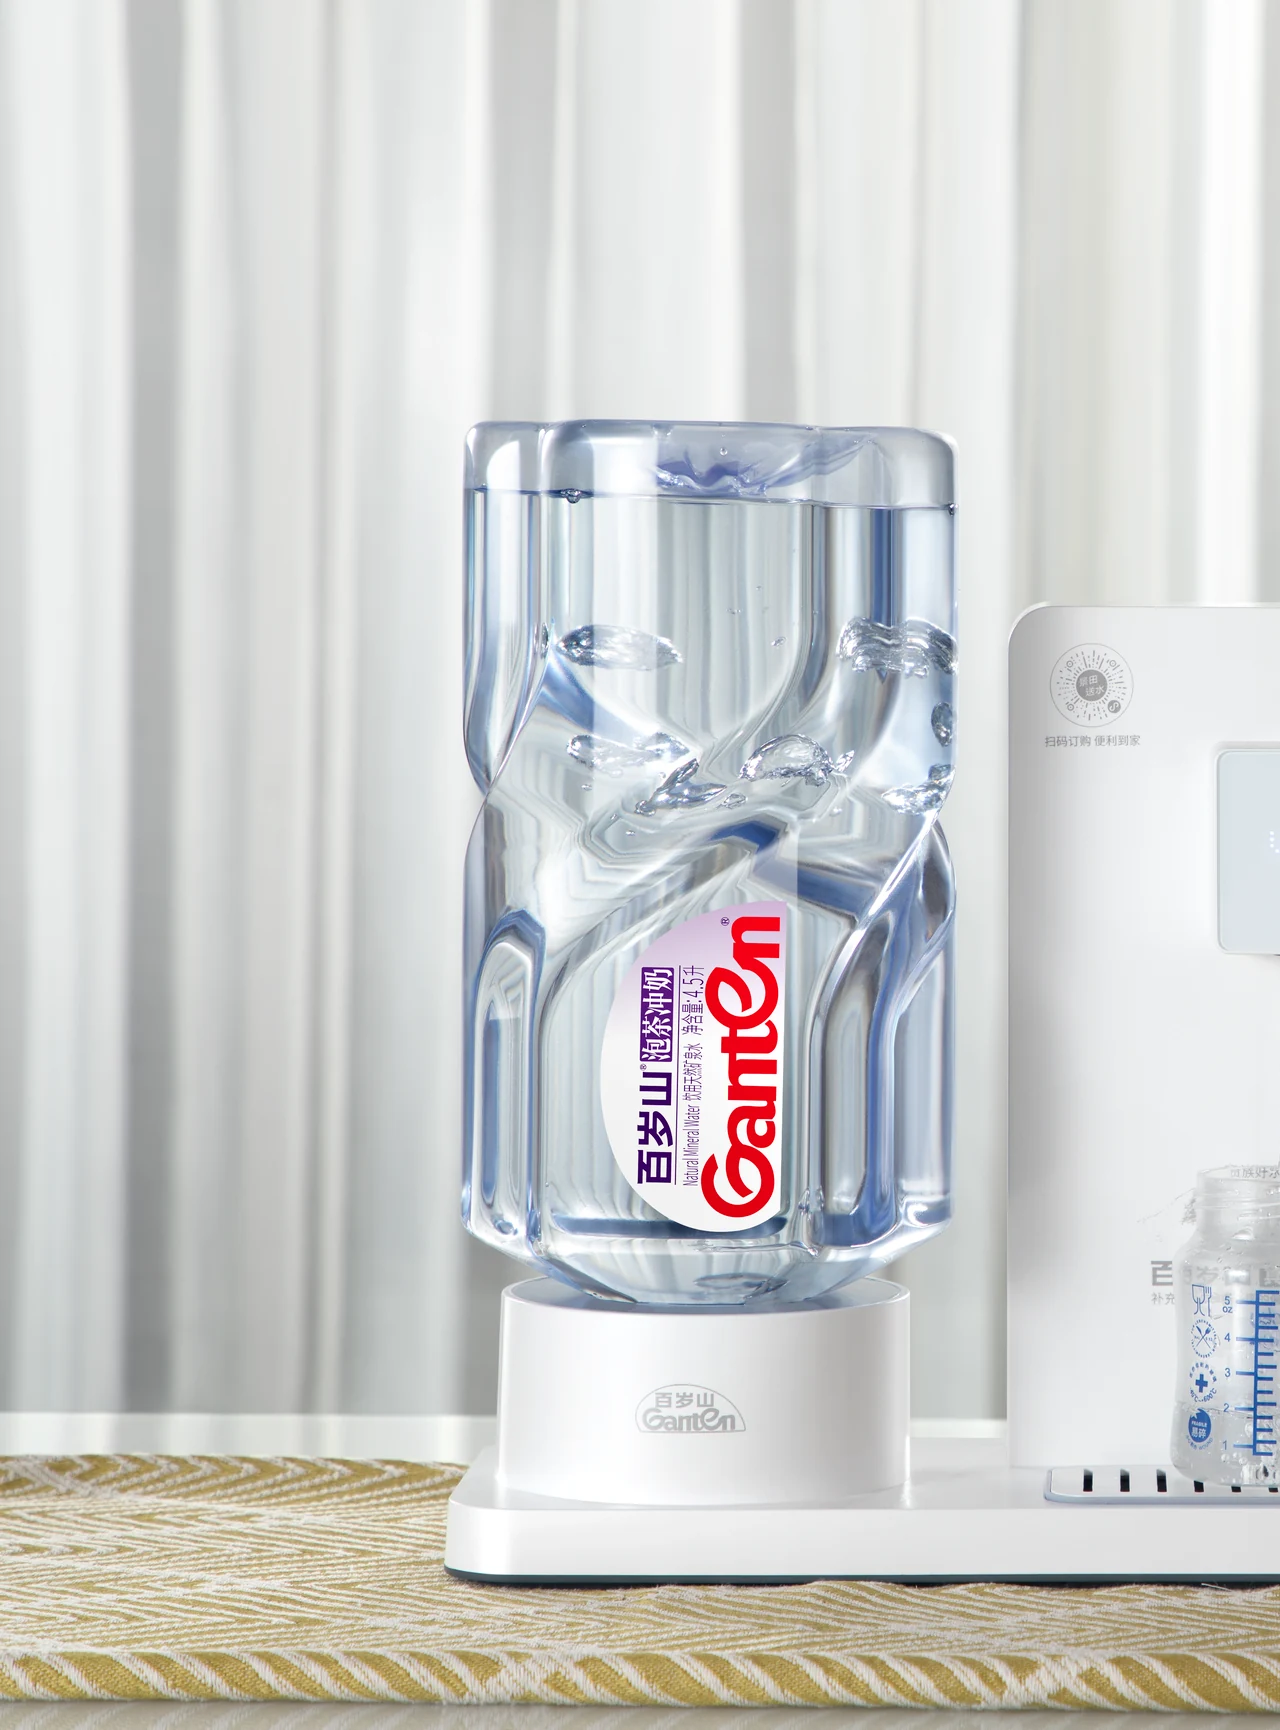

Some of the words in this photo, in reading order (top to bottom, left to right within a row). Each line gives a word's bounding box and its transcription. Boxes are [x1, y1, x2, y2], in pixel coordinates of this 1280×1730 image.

[1045, 735, 1091, 747] 扫码订购
[1094, 735, 1140, 746] 便利到家
[642, 967, 674, 1062] 泡茶冲奶
[683, 1043, 702, 1101] 饮用天然矿泉水
[701, 916, 780, 1218] Ganten
[683, 1105, 699, 1127] Water
[637, 1071, 674, 1184] 百岁山
[683, 1129, 699, 1156] Mineral
[683, 1157, 698, 1186] Natural
[1224, 1296, 1231, 1305] 5
[1224, 1333, 1231, 1342] 4
[1224, 1368, 1231, 1377] 3
[655, 1392, 714, 1408] 百岁山
[1223, 1403, 1230, 1412] 2
[642, 1407, 736, 1431] Ganten
[1223, 1440, 1228, 1450] 1
